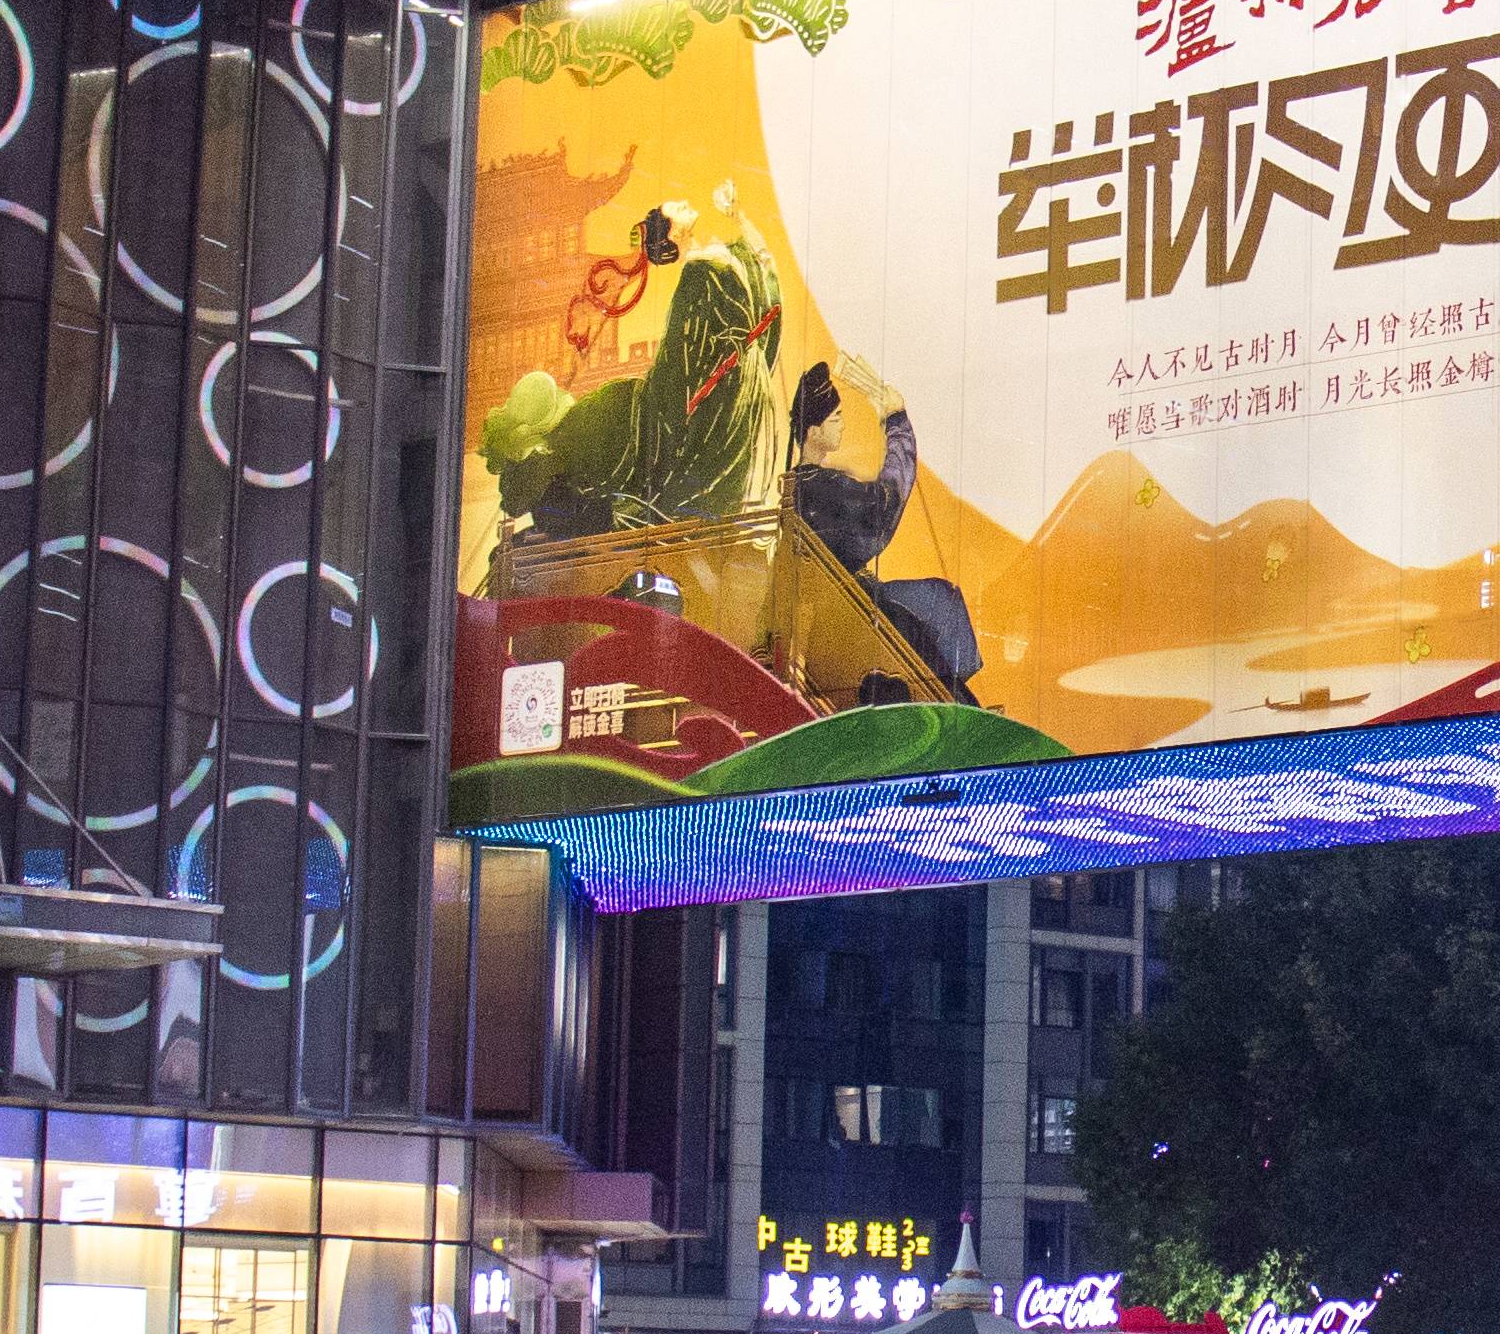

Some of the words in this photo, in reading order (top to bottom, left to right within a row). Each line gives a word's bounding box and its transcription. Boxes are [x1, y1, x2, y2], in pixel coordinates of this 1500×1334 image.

[1106, 328, 1300, 389] 今人不见古时月
[1107, 380, 1302, 442] 唯愿当歌对酒时
[1015, 1271, 1124, 1330] Coca-Cola
